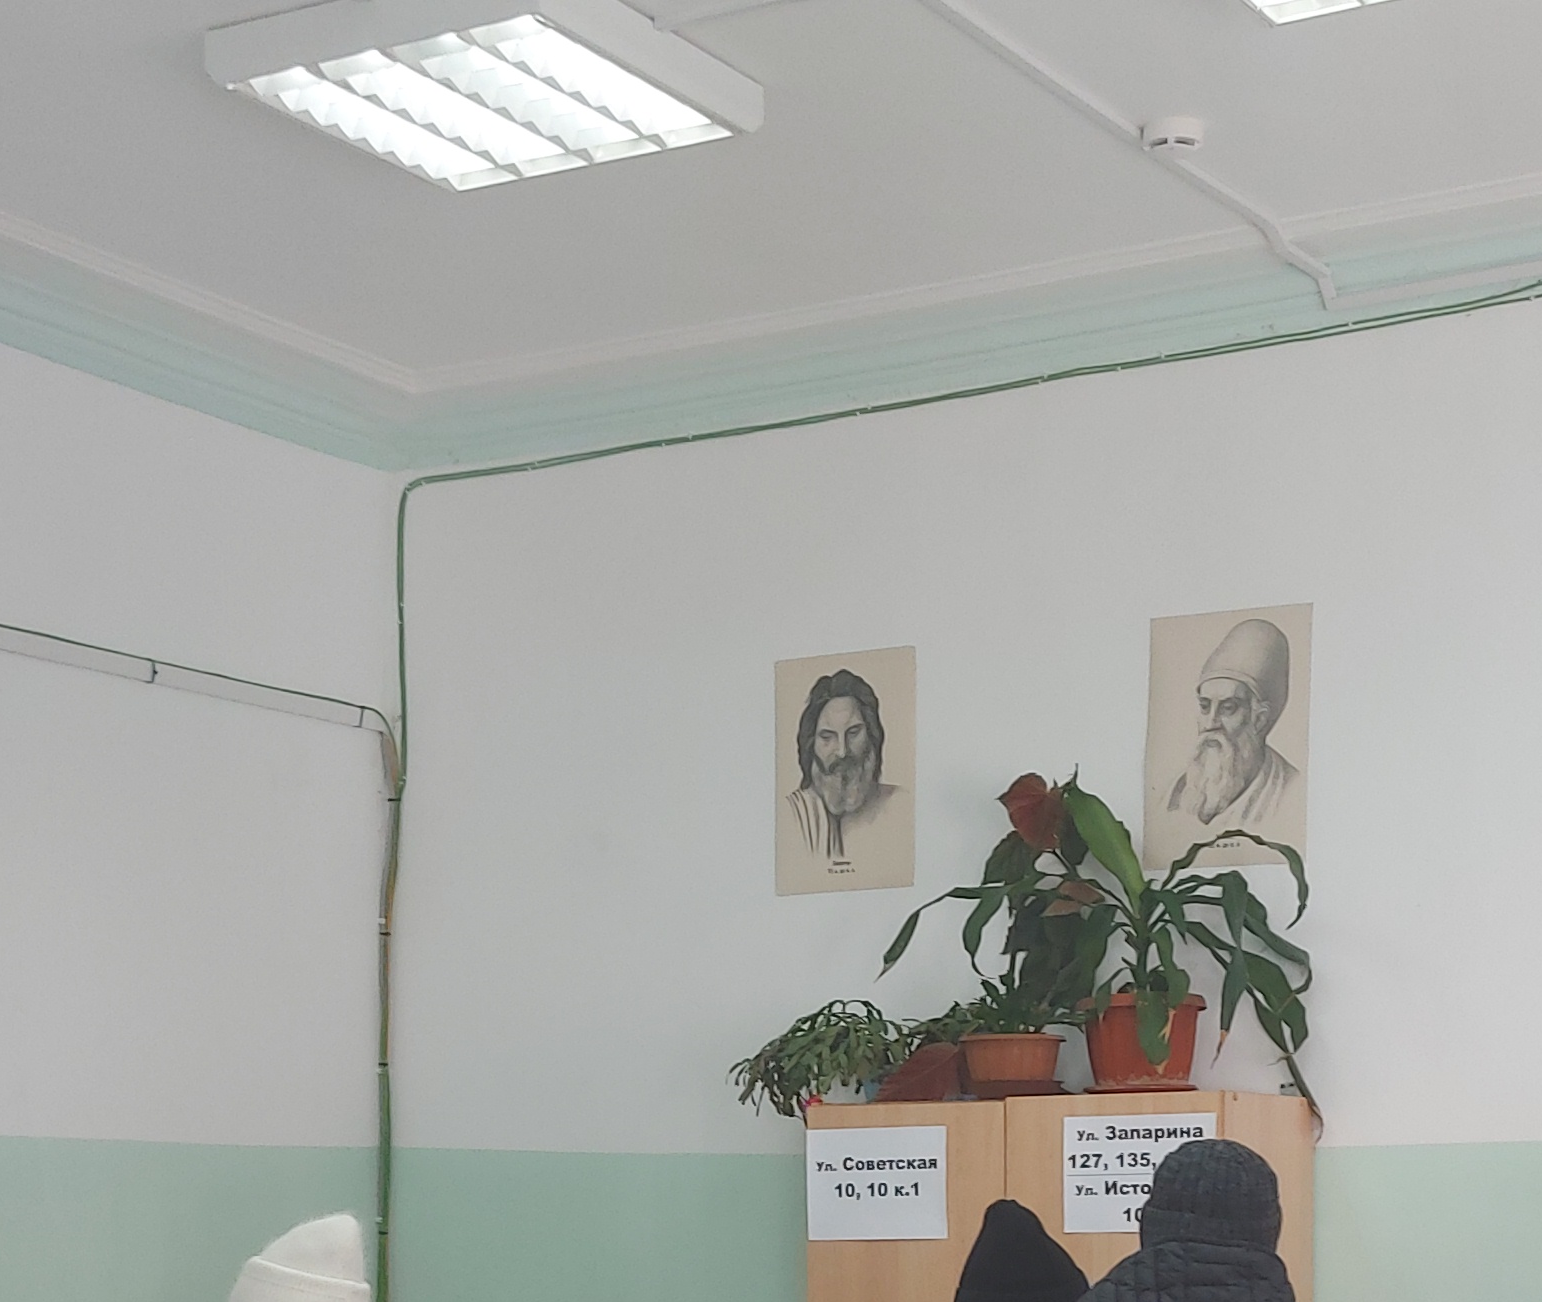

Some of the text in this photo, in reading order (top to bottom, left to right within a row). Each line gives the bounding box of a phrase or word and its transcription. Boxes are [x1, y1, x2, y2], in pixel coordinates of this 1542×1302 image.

[1104, 1125, 1205, 1143] Запарина
[842, 1156, 938, 1173] Советская
[1067, 1151, 1157, 1171] 127, 135,
[834, 1181, 920, 1201] 10, 10 к.1
[1104, 1180, 1152, 1196] Исто
